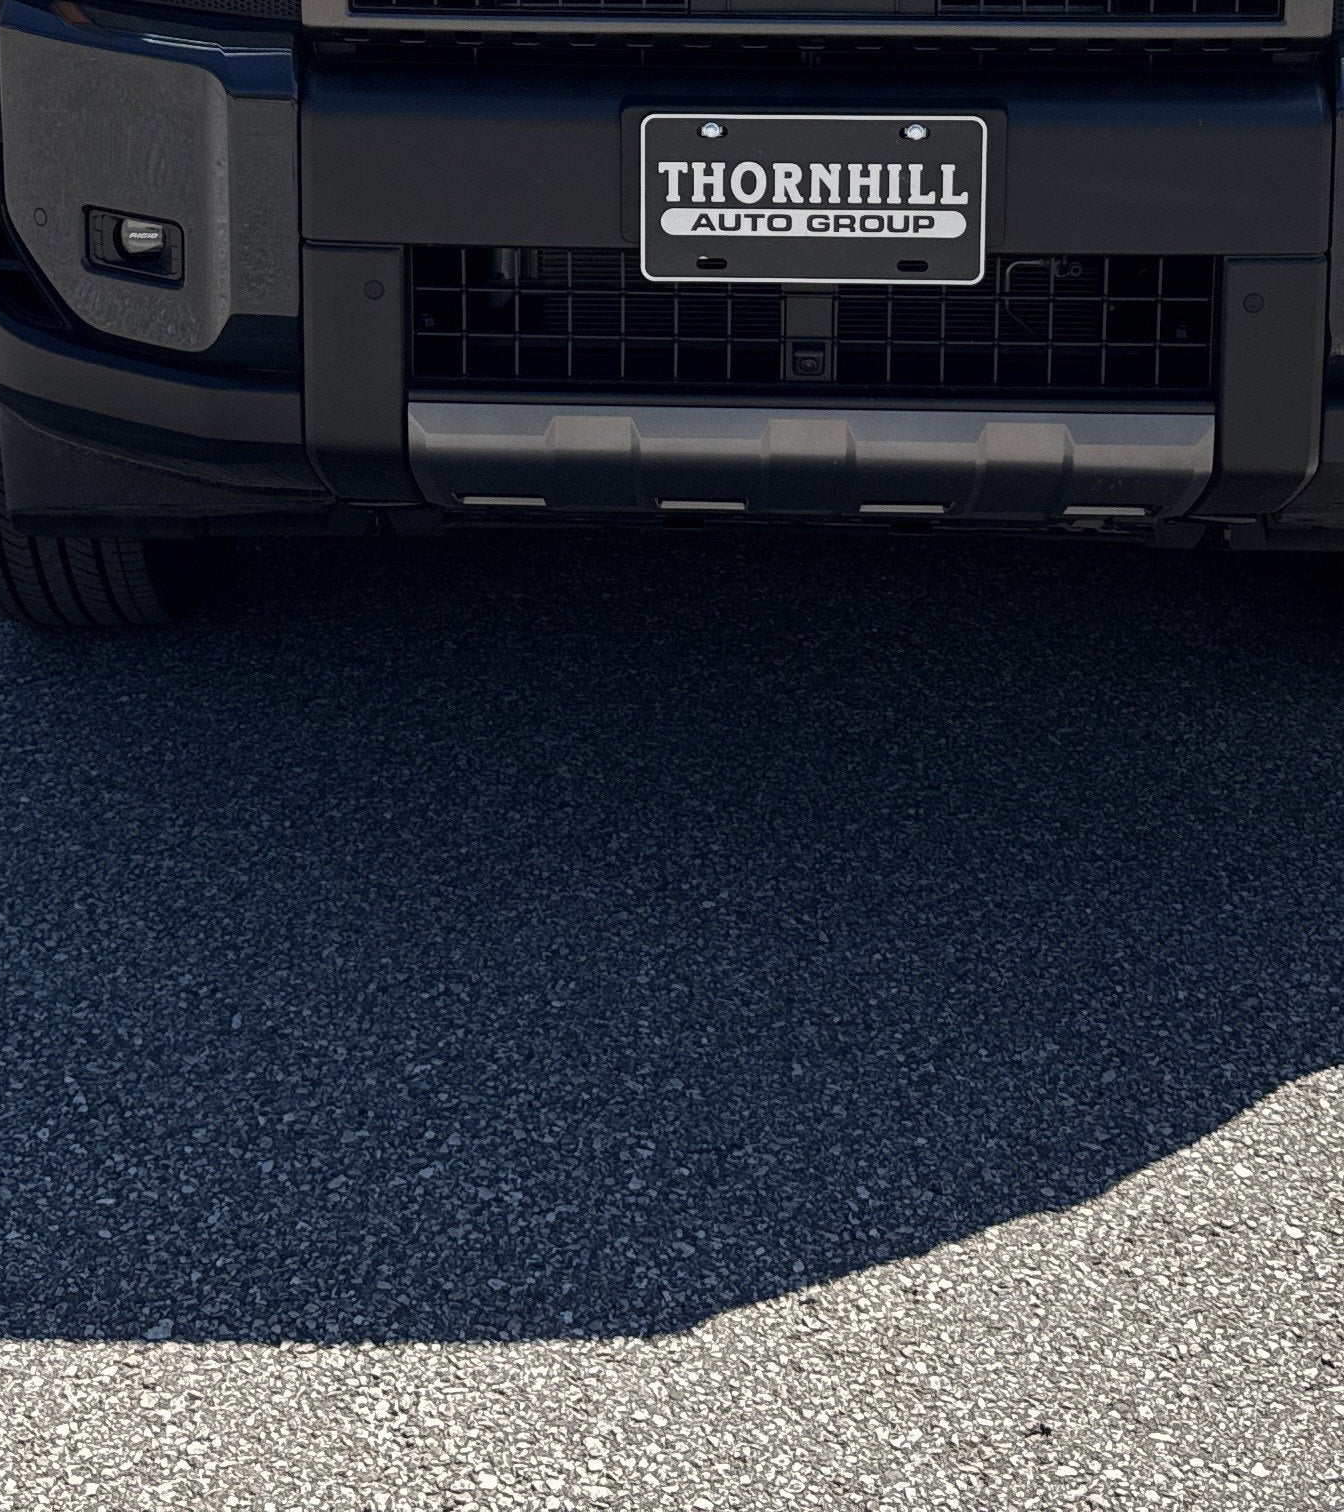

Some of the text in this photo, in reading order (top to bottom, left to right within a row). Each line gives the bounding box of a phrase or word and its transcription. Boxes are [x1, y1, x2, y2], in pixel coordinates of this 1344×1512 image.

[658, 161, 969, 205] THORNHILL
[690, 213, 936, 234] AUTO GROUP
